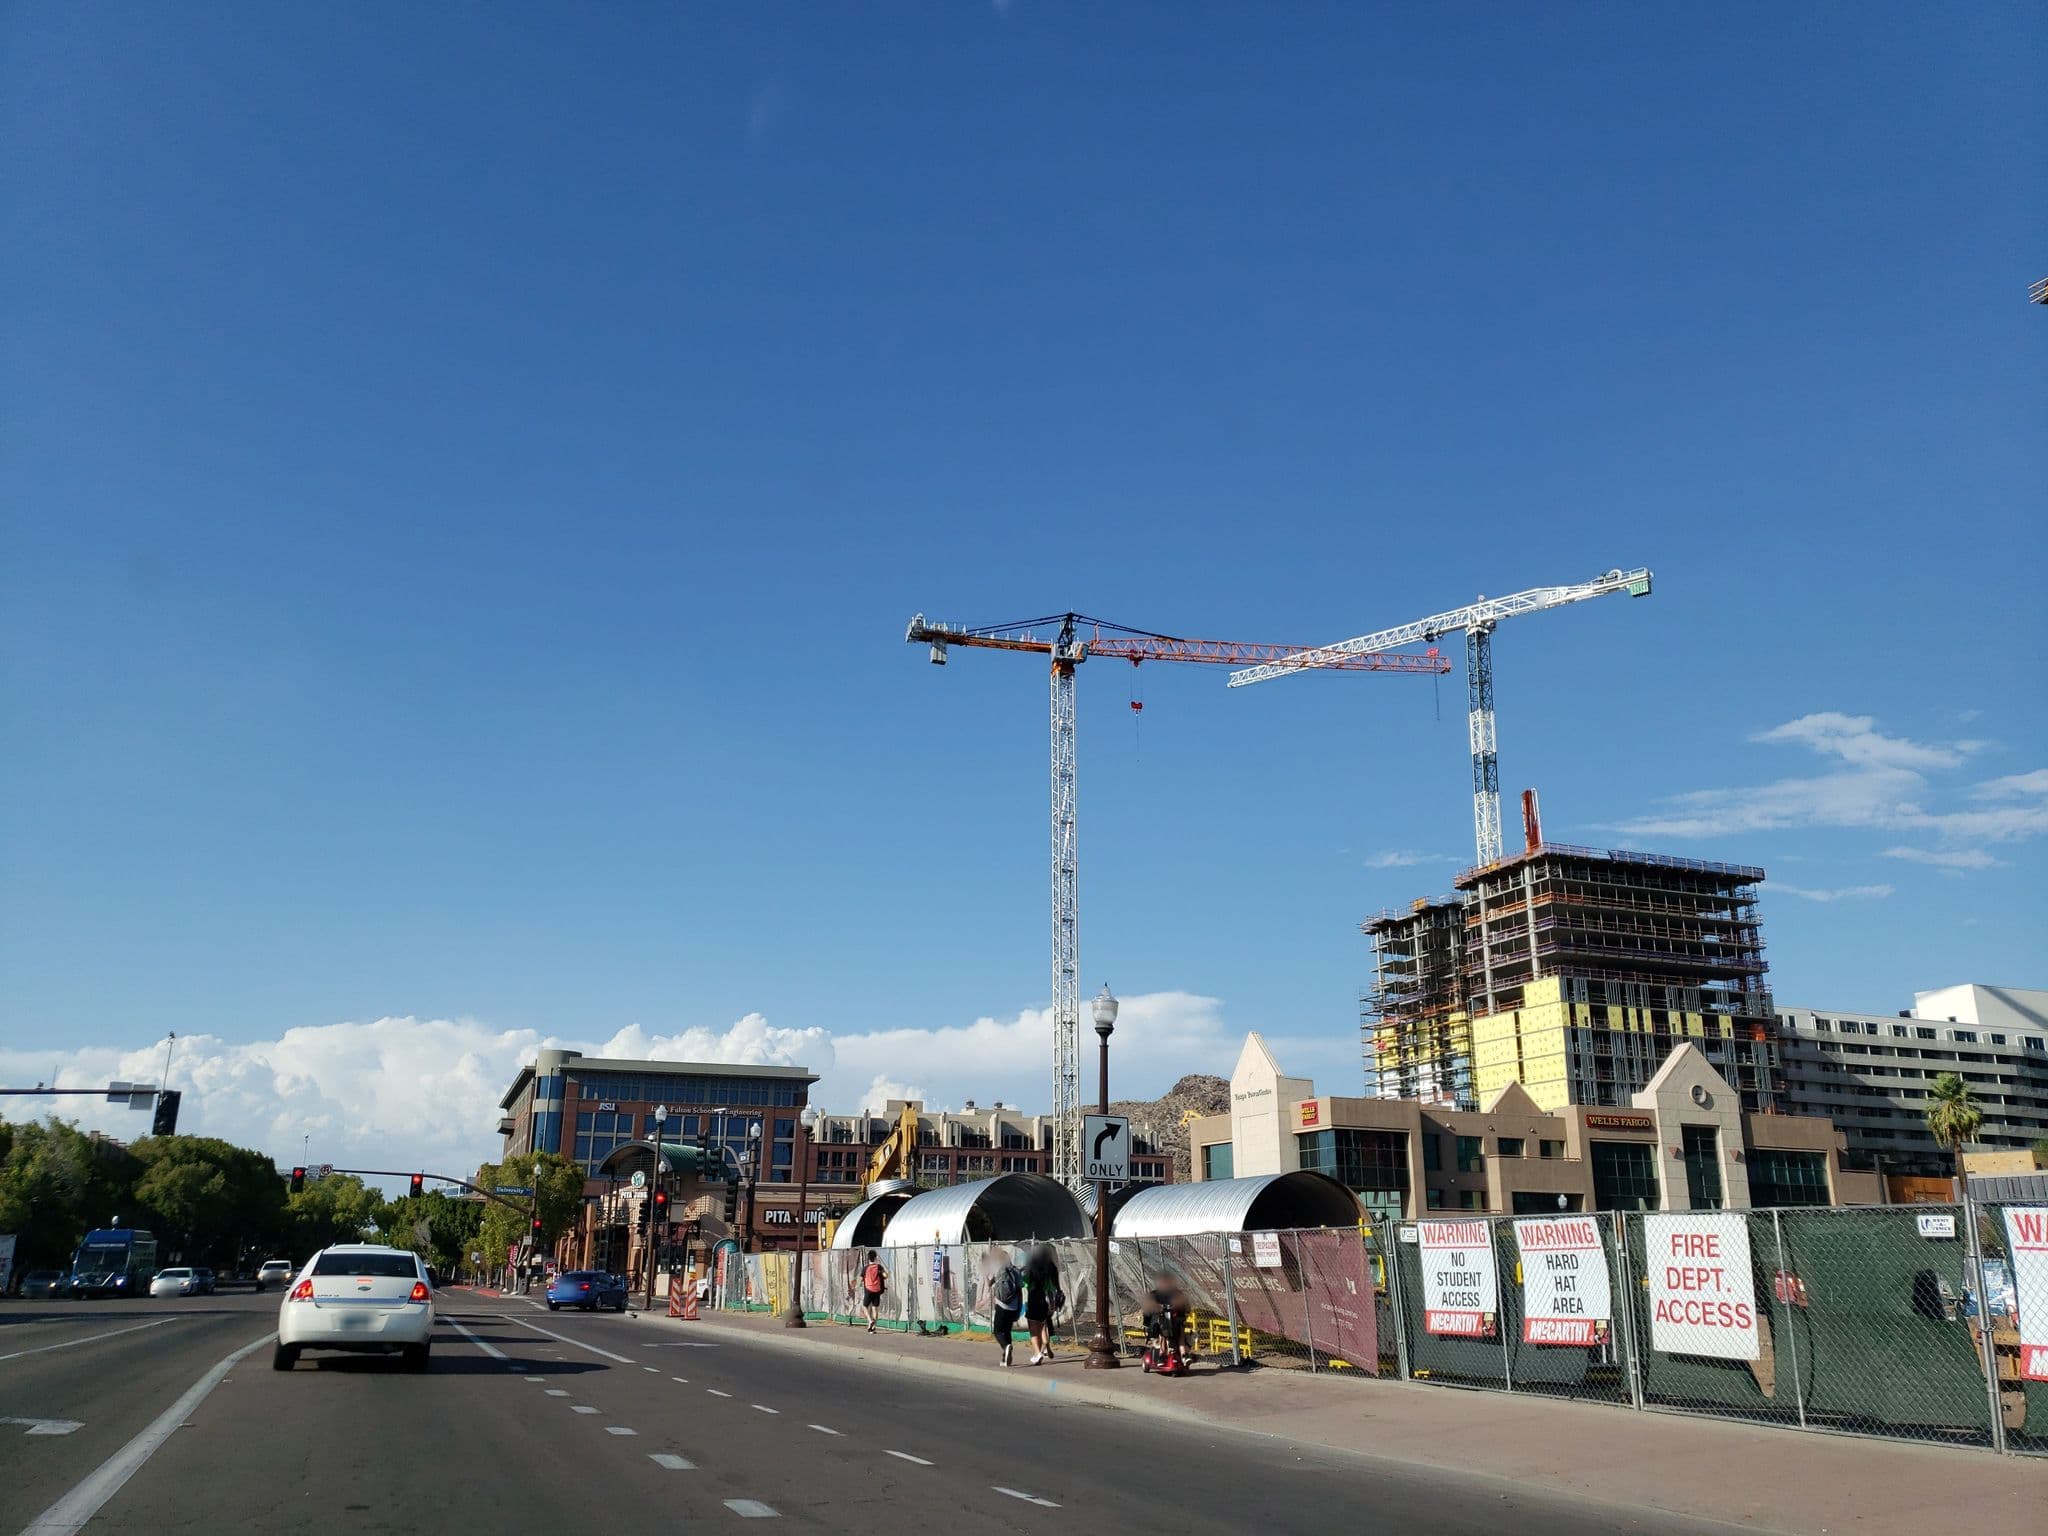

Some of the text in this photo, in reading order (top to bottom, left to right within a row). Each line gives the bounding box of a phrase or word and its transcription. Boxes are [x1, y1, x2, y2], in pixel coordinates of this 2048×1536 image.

[1589, 1117, 1650, 1127] WELLS FARGO
[1089, 1163, 1124, 1177] ONLY
[765, 1210, 791, 1223] PITA
[1423, 1222, 1486, 1245] WARNING
[1520, 1222, 1595, 1246] WARNING
[1671, 1233, 1721, 1258] FIRE
[1451, 1251, 1465, 1267] NO
[1545, 1254, 1579, 1270] HARD
[1437, 1272, 1482, 1287] STUDENT
[1554, 1275, 1577, 1292] HAT
[1666, 1266, 1732, 1293] DEPT.
[1441, 1291, 1481, 1307] ACCESS
[1552, 1298, 1584, 1314] AREA
[1655, 1299, 1752, 1329] ACCESS
